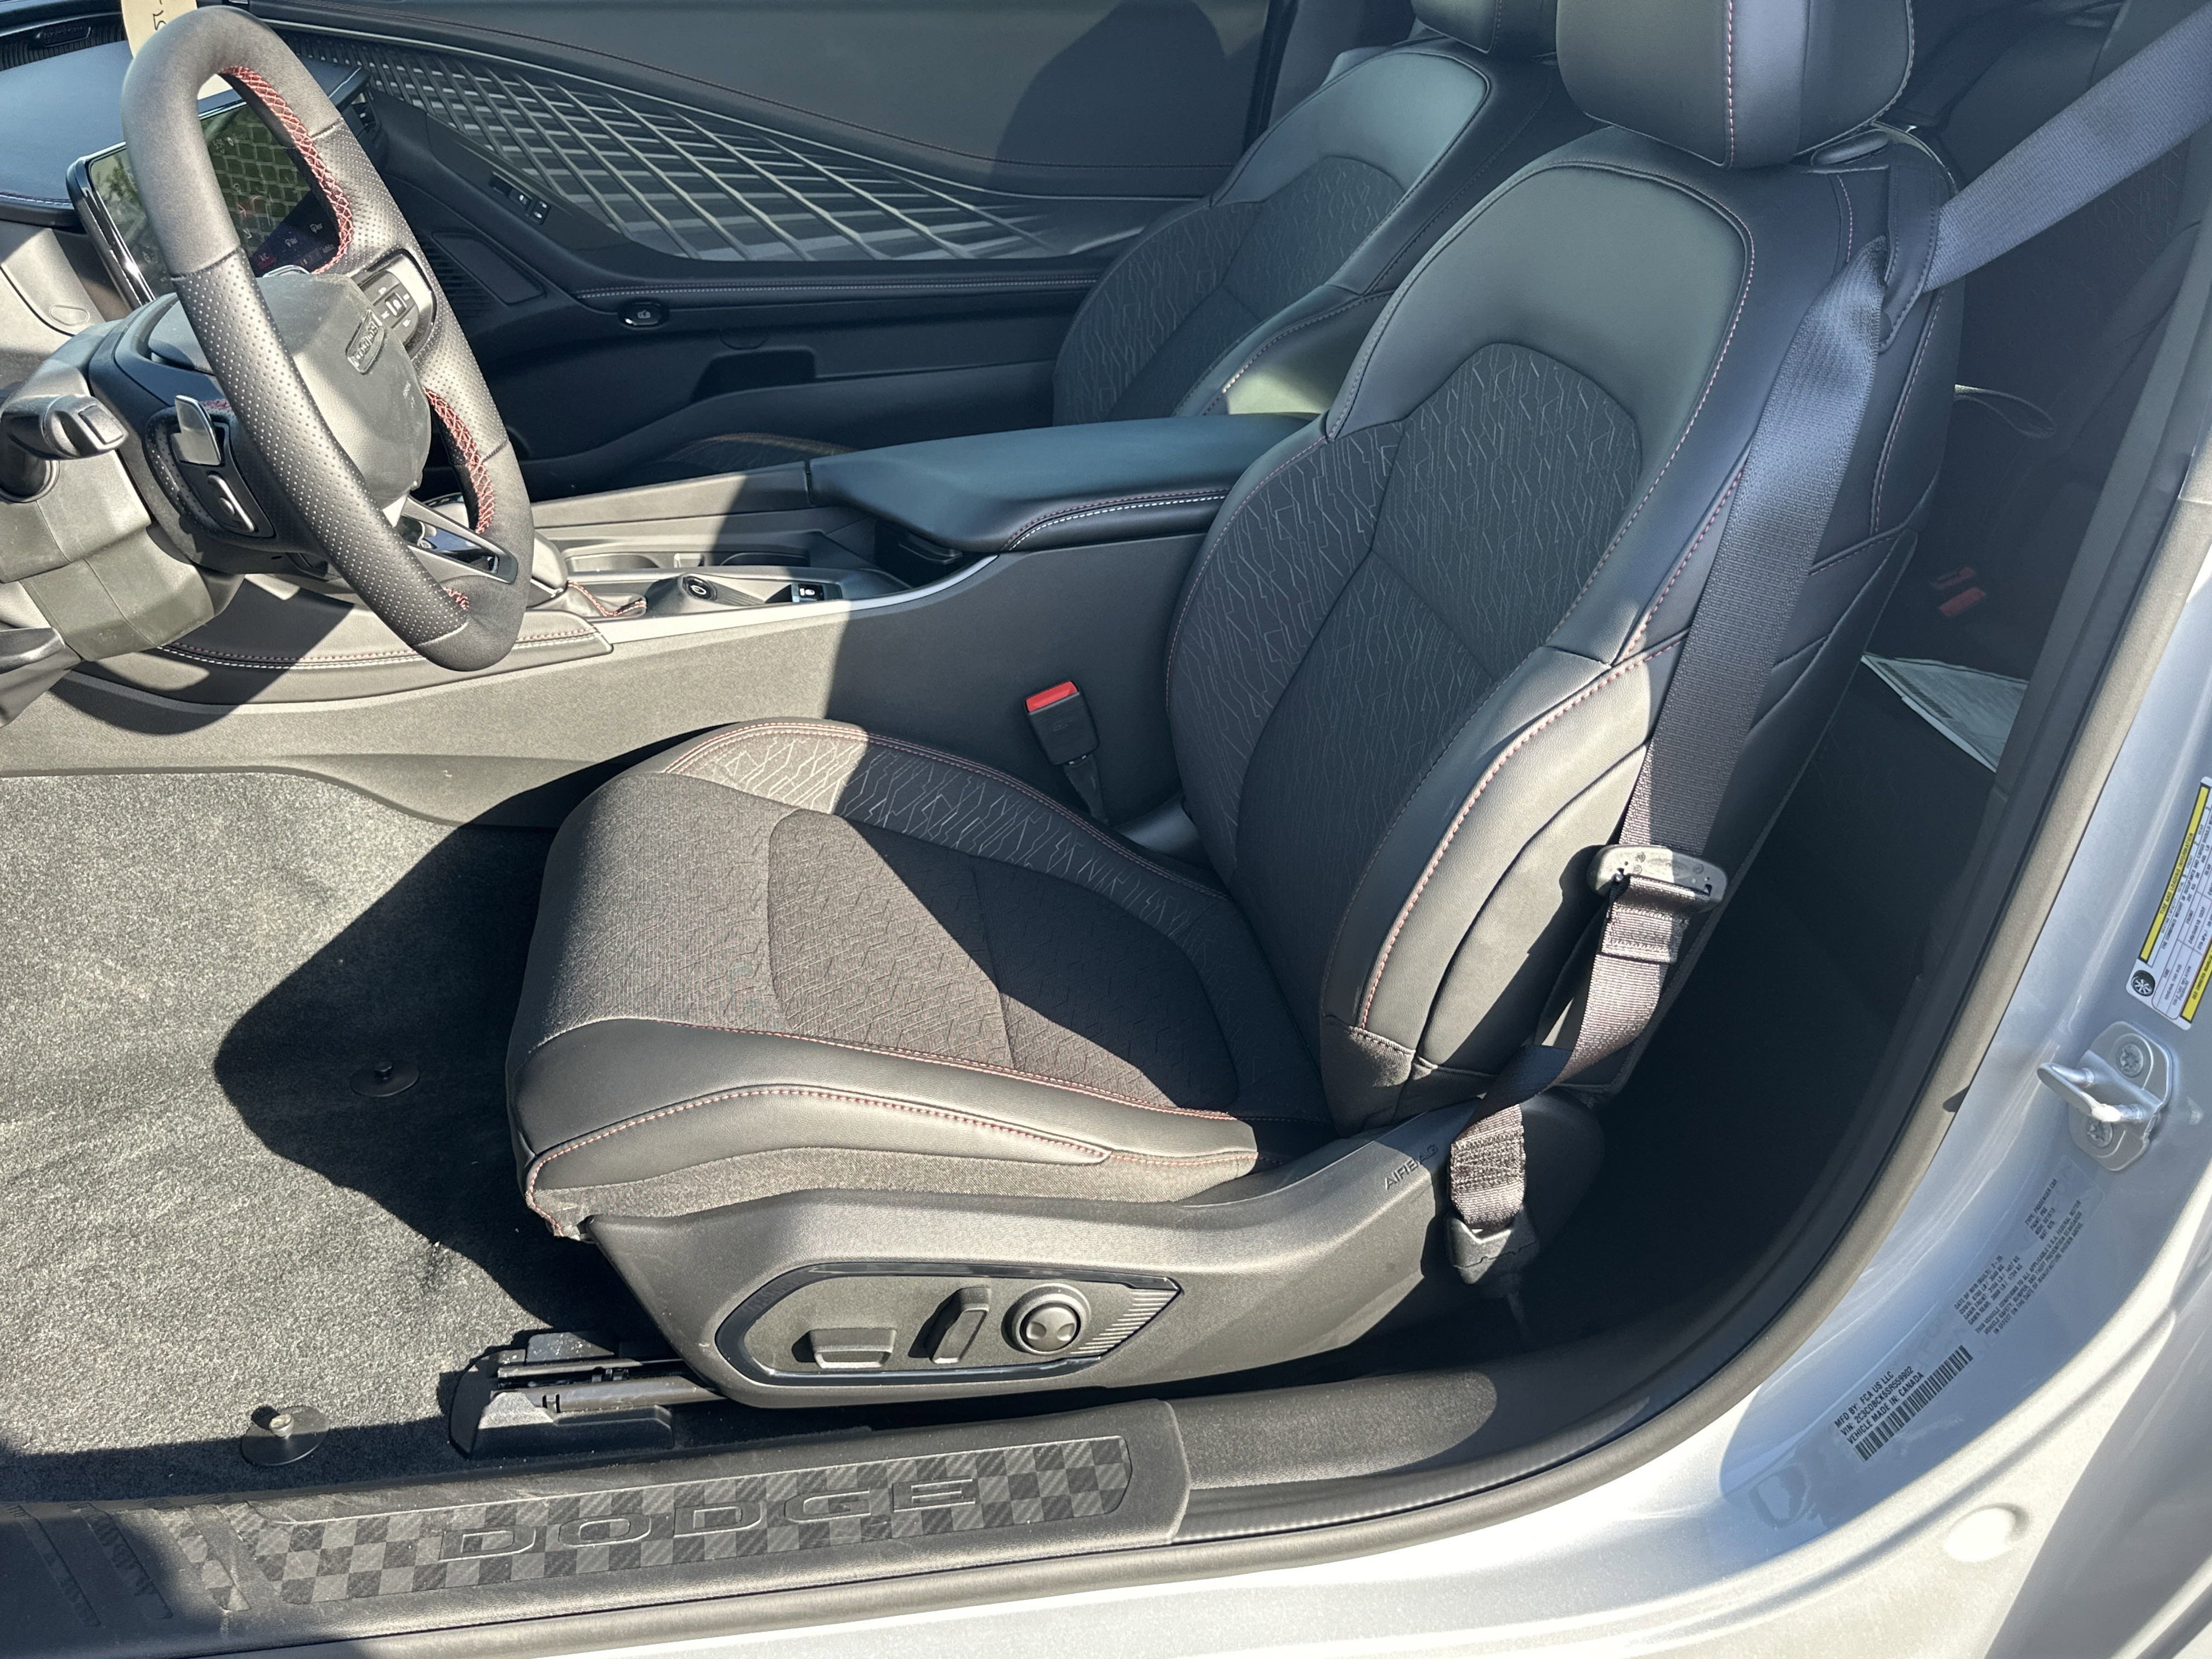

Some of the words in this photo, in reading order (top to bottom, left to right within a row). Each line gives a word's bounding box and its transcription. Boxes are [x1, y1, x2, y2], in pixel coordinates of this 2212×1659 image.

[1385, 1144, 1438, 1190] AIRBAG
[1835, 1413, 1849, 1427] MFD
[1848, 1403, 1859, 1414] BY:
[1860, 1391, 1873, 1404] FCA
[1871, 1381, 1882, 1392] US
[1880, 1371, 1894, 1384] LLC
[1847, 1419, 1872, 1444] VEHICLE
[1871, 1403, 1890, 1422] MADE
[1889, 1396, 1899, 1406] IN:
[1899, 1372, 1923, 1396] CANADA
[1840, 1423, 1855, 1436] VIN:
[438, 1477, 977, 1562] DODGE
